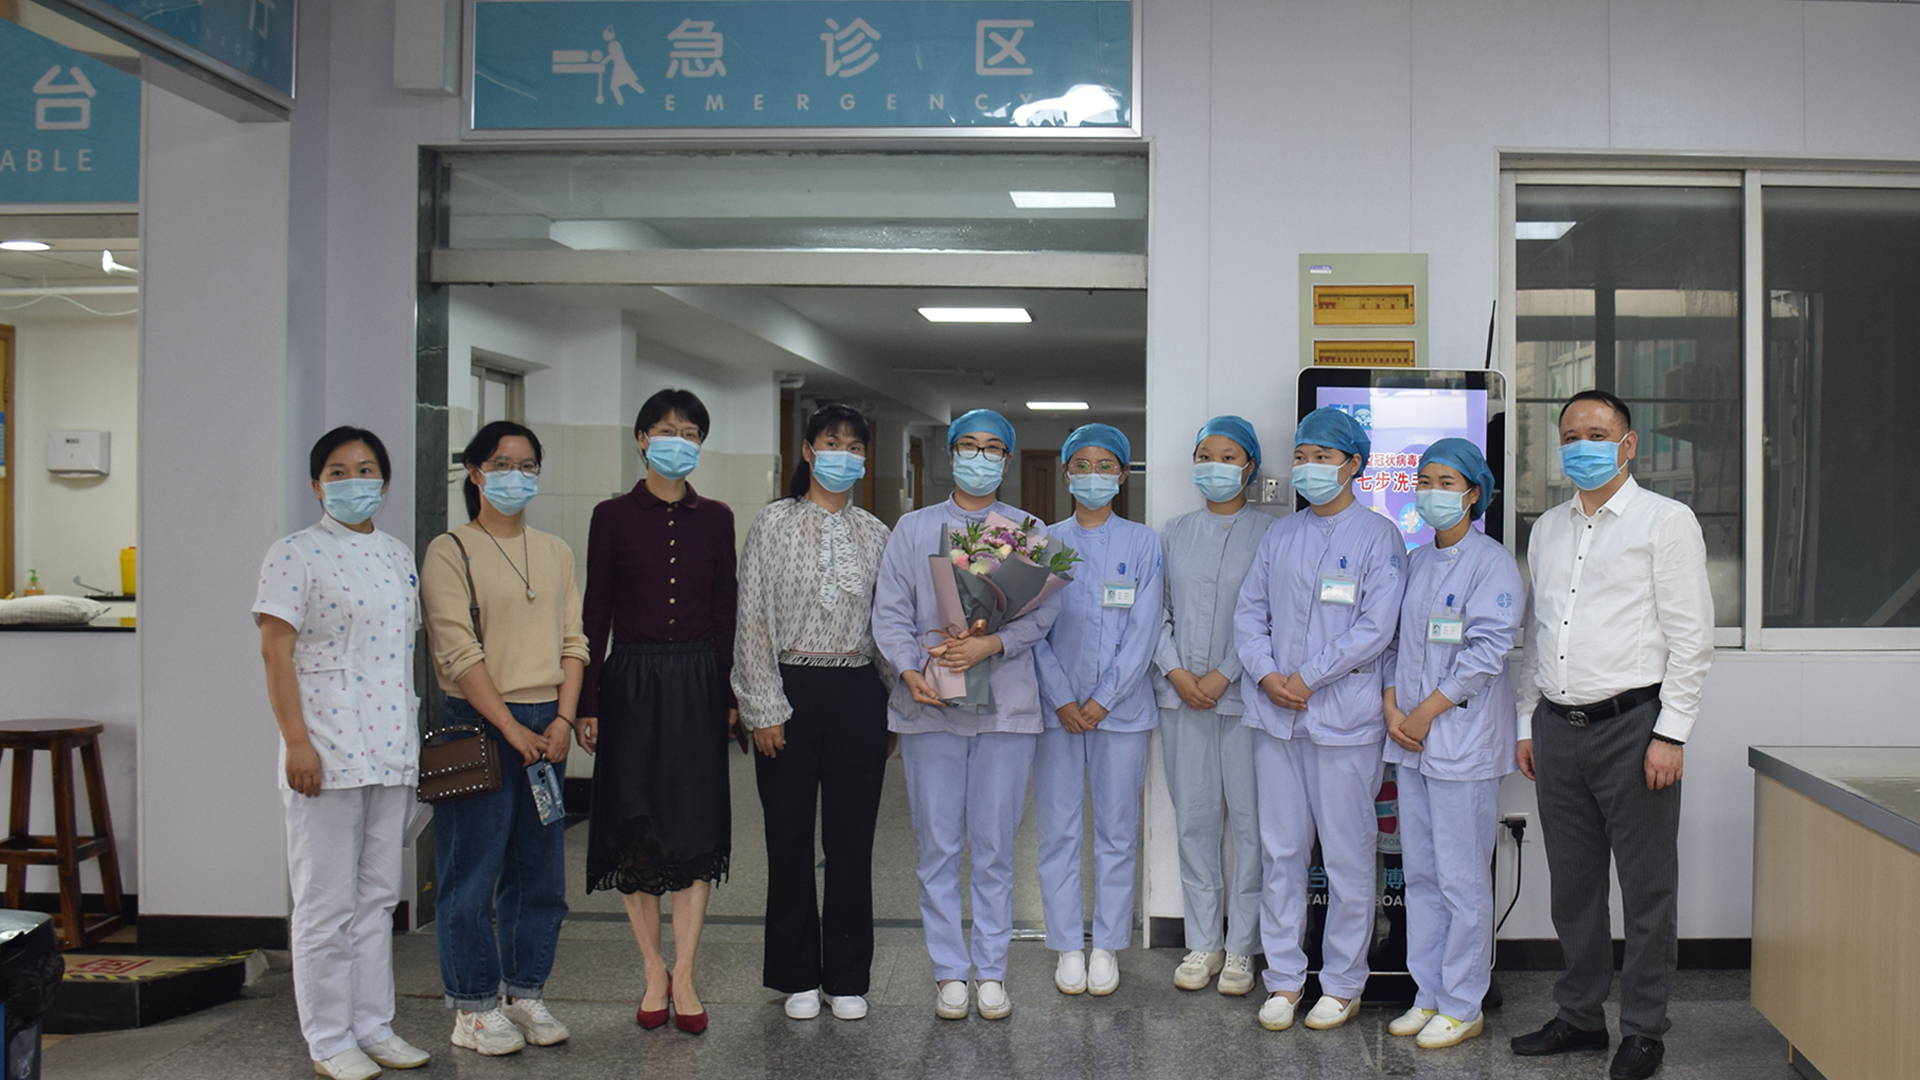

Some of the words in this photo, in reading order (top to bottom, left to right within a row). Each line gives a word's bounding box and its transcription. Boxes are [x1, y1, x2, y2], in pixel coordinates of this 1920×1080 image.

[665, 17, 1035, 79] 急诊区
[32, 64, 96, 130] 台
[664, 93, 1034, 111] EMERGENCY
[1366, 455, 1422, 466] 冠状病毒
[1307, 892, 1328, 905] TAI
[1376, 895, 1406, 907] BOA
